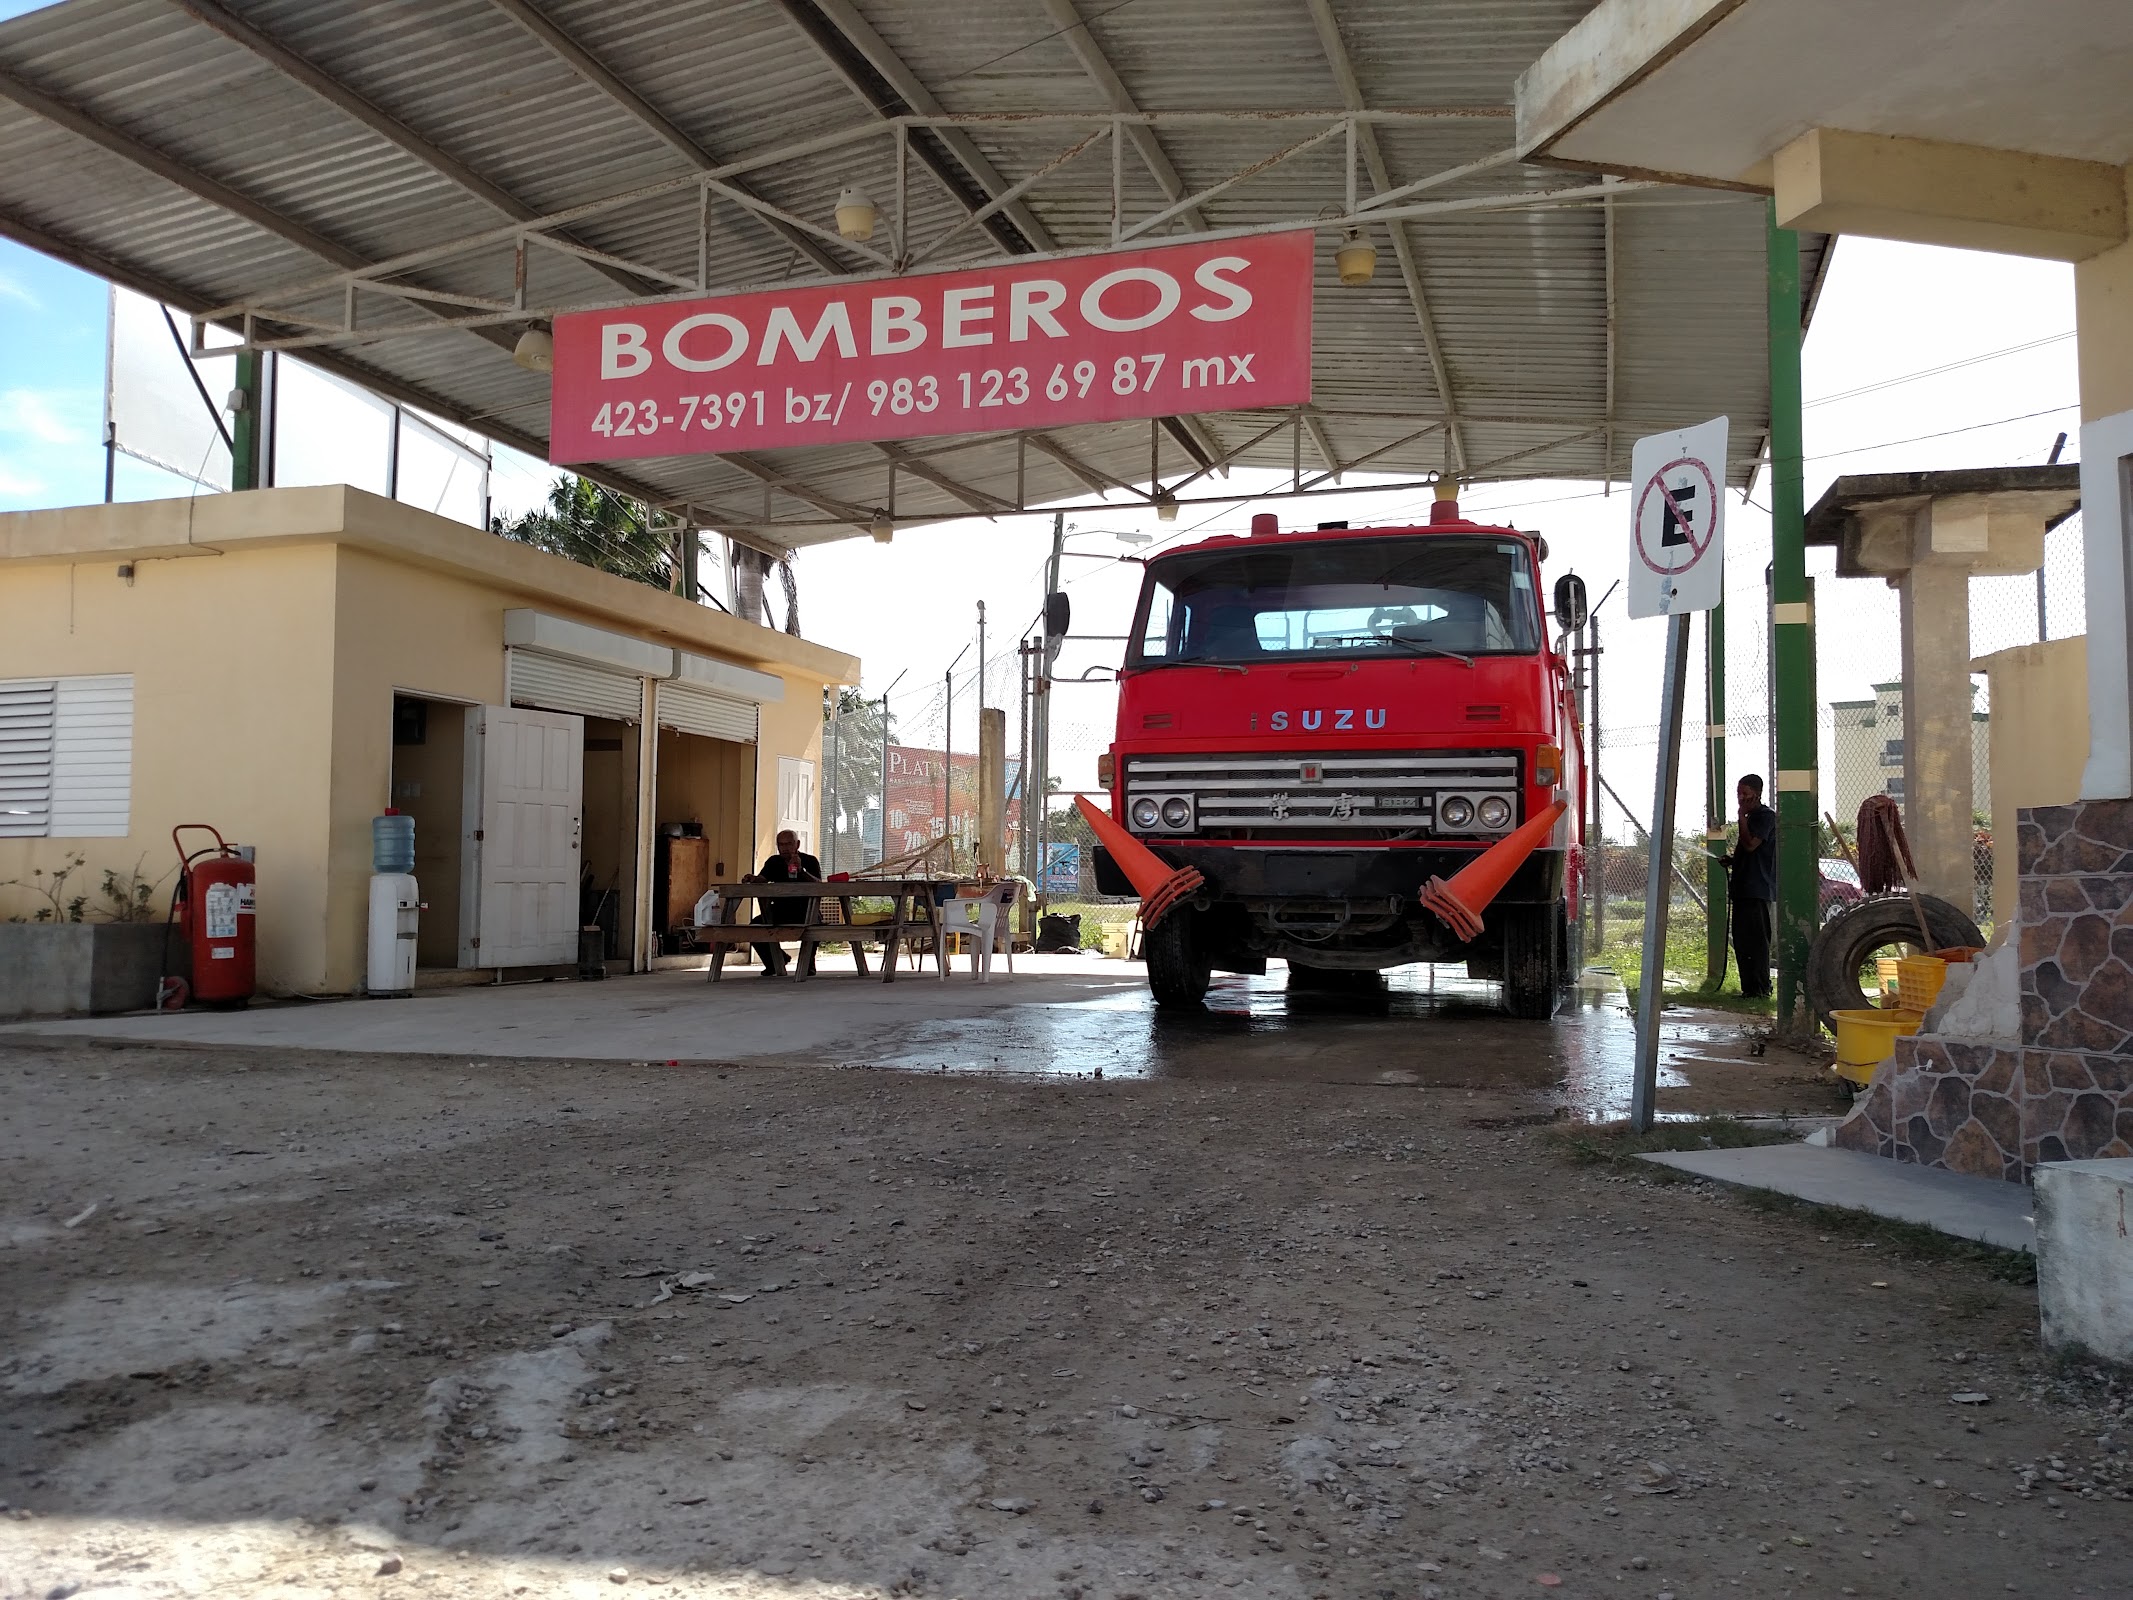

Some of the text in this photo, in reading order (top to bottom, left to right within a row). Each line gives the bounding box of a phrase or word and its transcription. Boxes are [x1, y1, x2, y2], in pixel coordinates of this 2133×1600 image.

[600, 256, 1254, 380] BOMBEROS
[591, 353, 1257, 438] 423-7391 bz/ 983 123 69 87 mx
[1661, 484, 1696, 548] E
